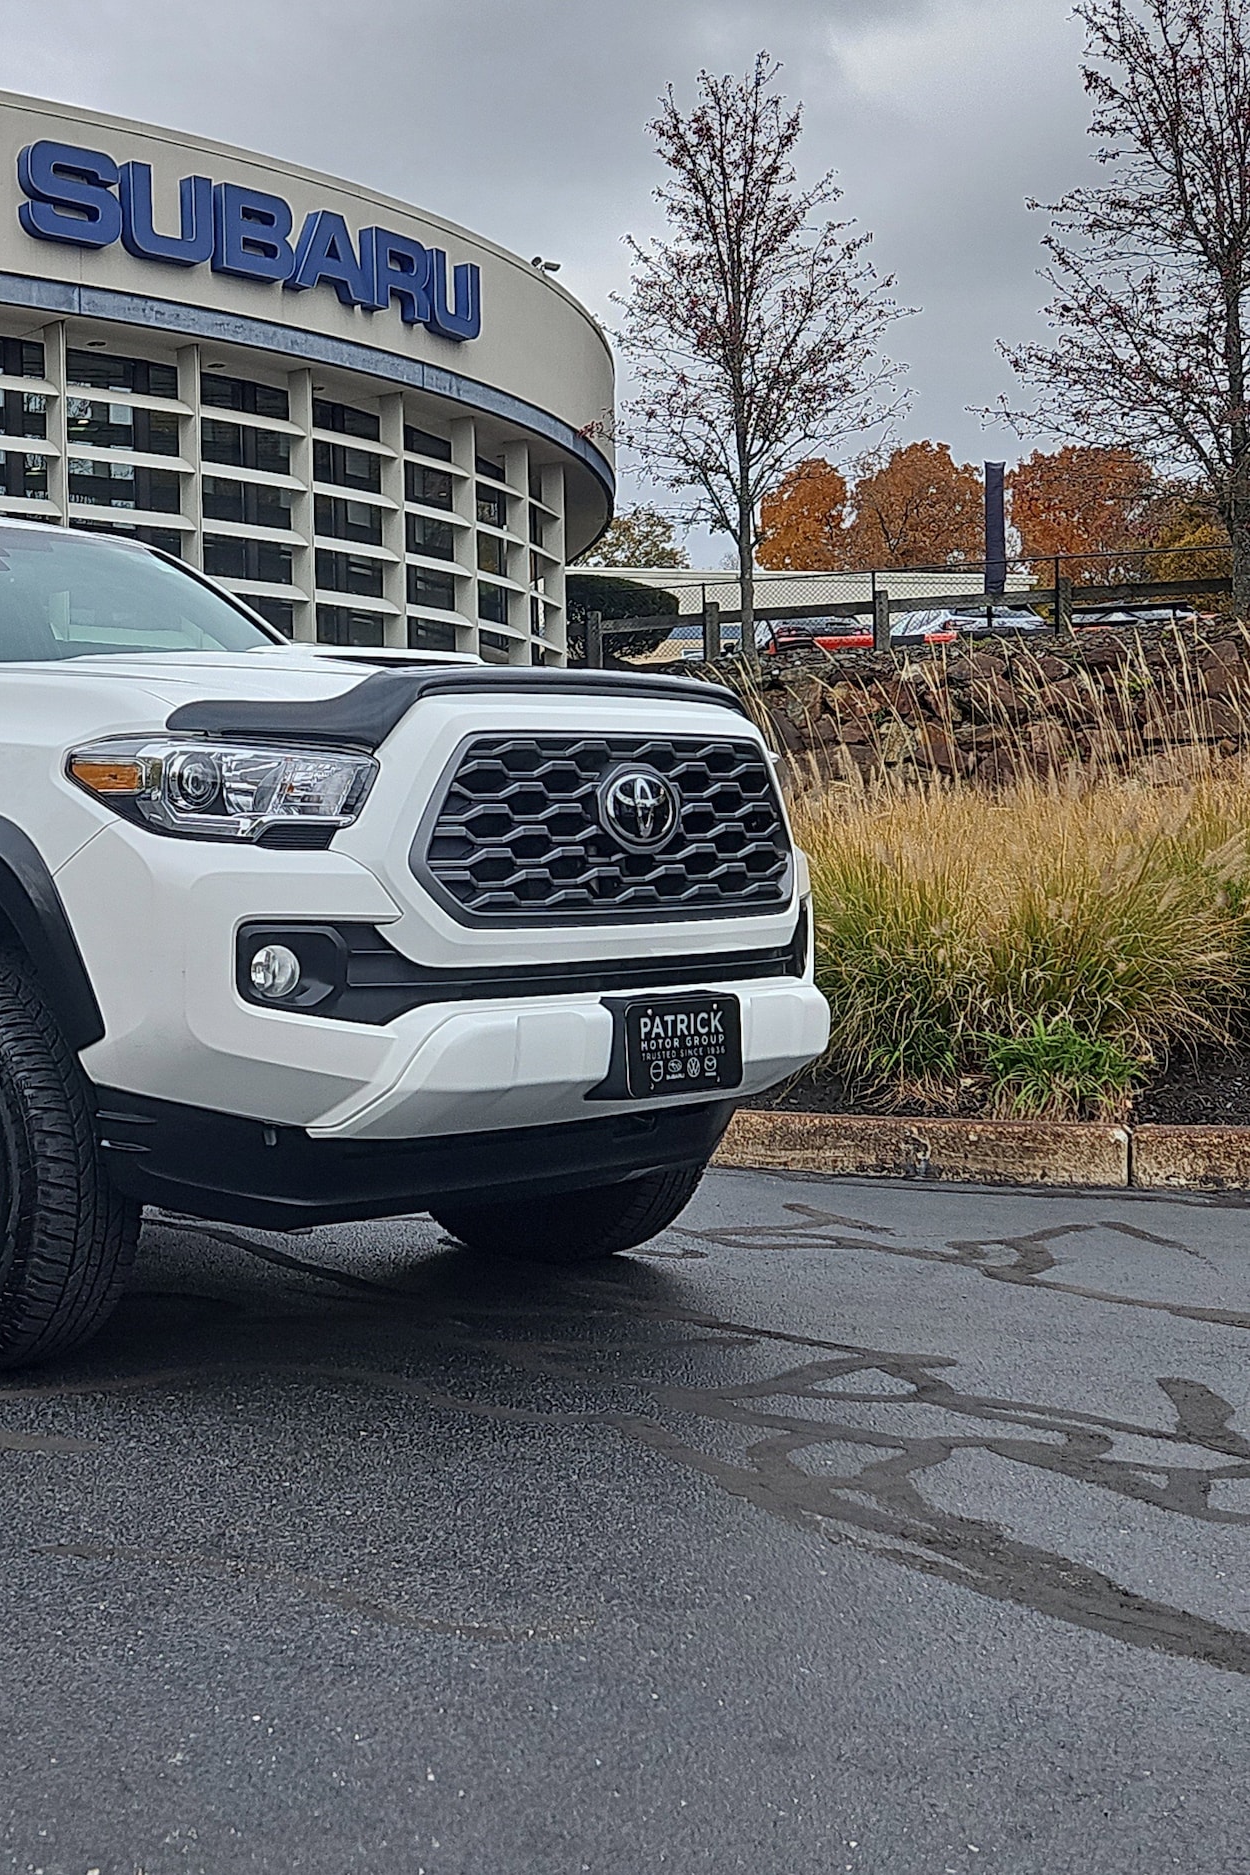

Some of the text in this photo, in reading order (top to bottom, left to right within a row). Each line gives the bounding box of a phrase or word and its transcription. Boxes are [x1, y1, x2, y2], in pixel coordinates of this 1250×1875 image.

[17, 139, 481, 342] SUBARU
[639, 1011, 724, 1040] PATRICK
[640, 1034, 725, 1052] MOTOR GROUP
[641, 1050, 677, 1061] TRUSTED
[680, 1047, 704, 1058] SINCE
